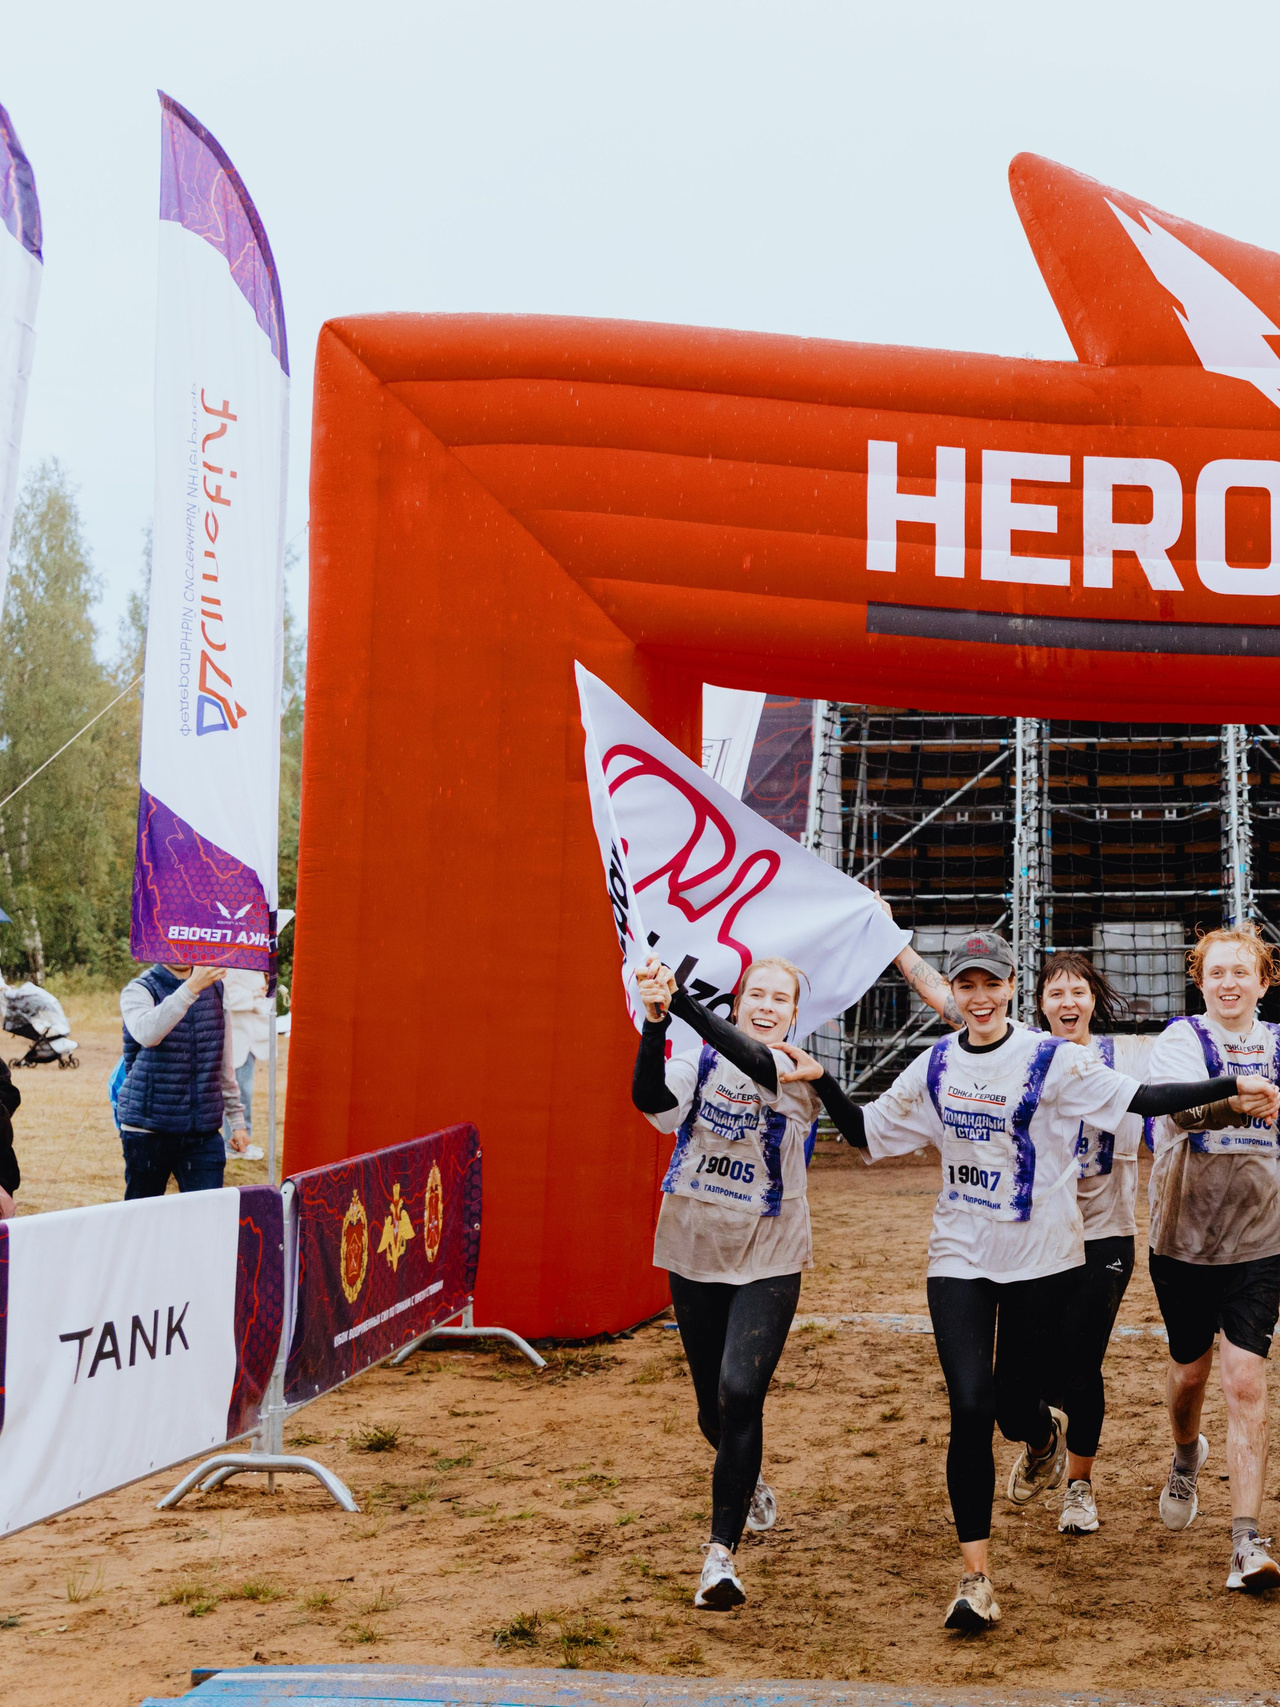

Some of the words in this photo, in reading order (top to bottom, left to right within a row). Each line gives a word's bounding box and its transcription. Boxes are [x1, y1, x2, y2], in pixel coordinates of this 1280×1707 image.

[948, 1086, 972, 1098] ГОНКА
[975, 1092, 1006, 1103] ГЕРОЕВ
[945, 1109, 1005, 1131] КОМАНДНЫЙ
[957, 1127, 988, 1140] СТАРТ
[696, 1154, 755, 1184] 19005
[948, 1165, 1001, 1192] 19007
[703, 1184, 753, 1203] ГАЗПРОМБАНК
[59, 1301, 189, 1384] TANK
